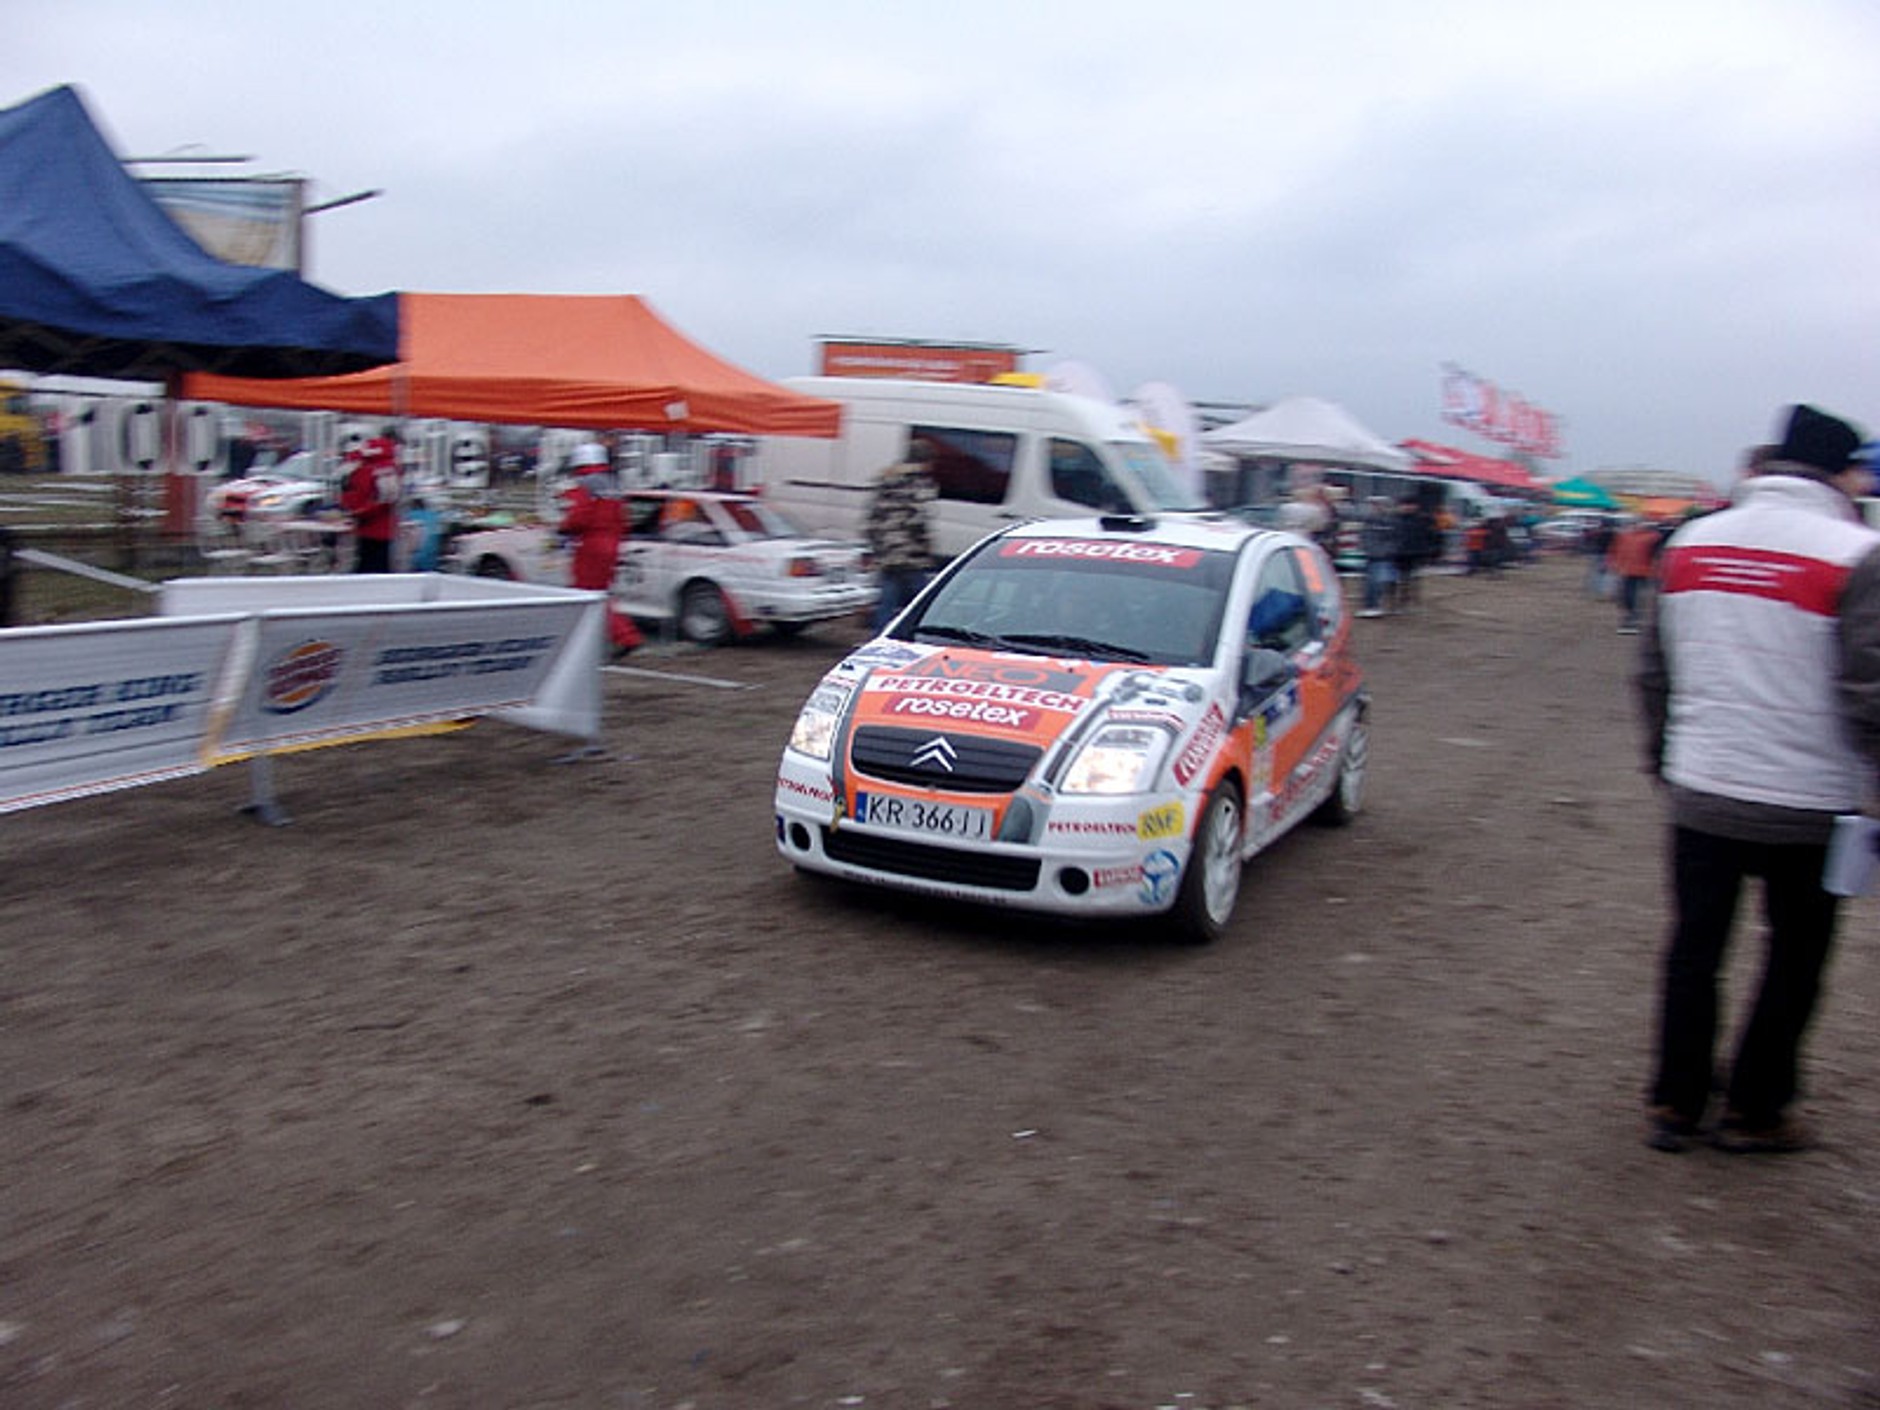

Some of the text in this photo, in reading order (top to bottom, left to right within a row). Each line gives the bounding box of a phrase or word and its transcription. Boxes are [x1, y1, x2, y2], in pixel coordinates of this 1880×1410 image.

[1016, 540, 1180, 564] rosetex
[920, 659, 1049, 686] NEO
[879, 677, 1085, 712] PETROELTECH
[894, 697, 1029, 726] rosetex
[869, 796, 904, 823] KR
